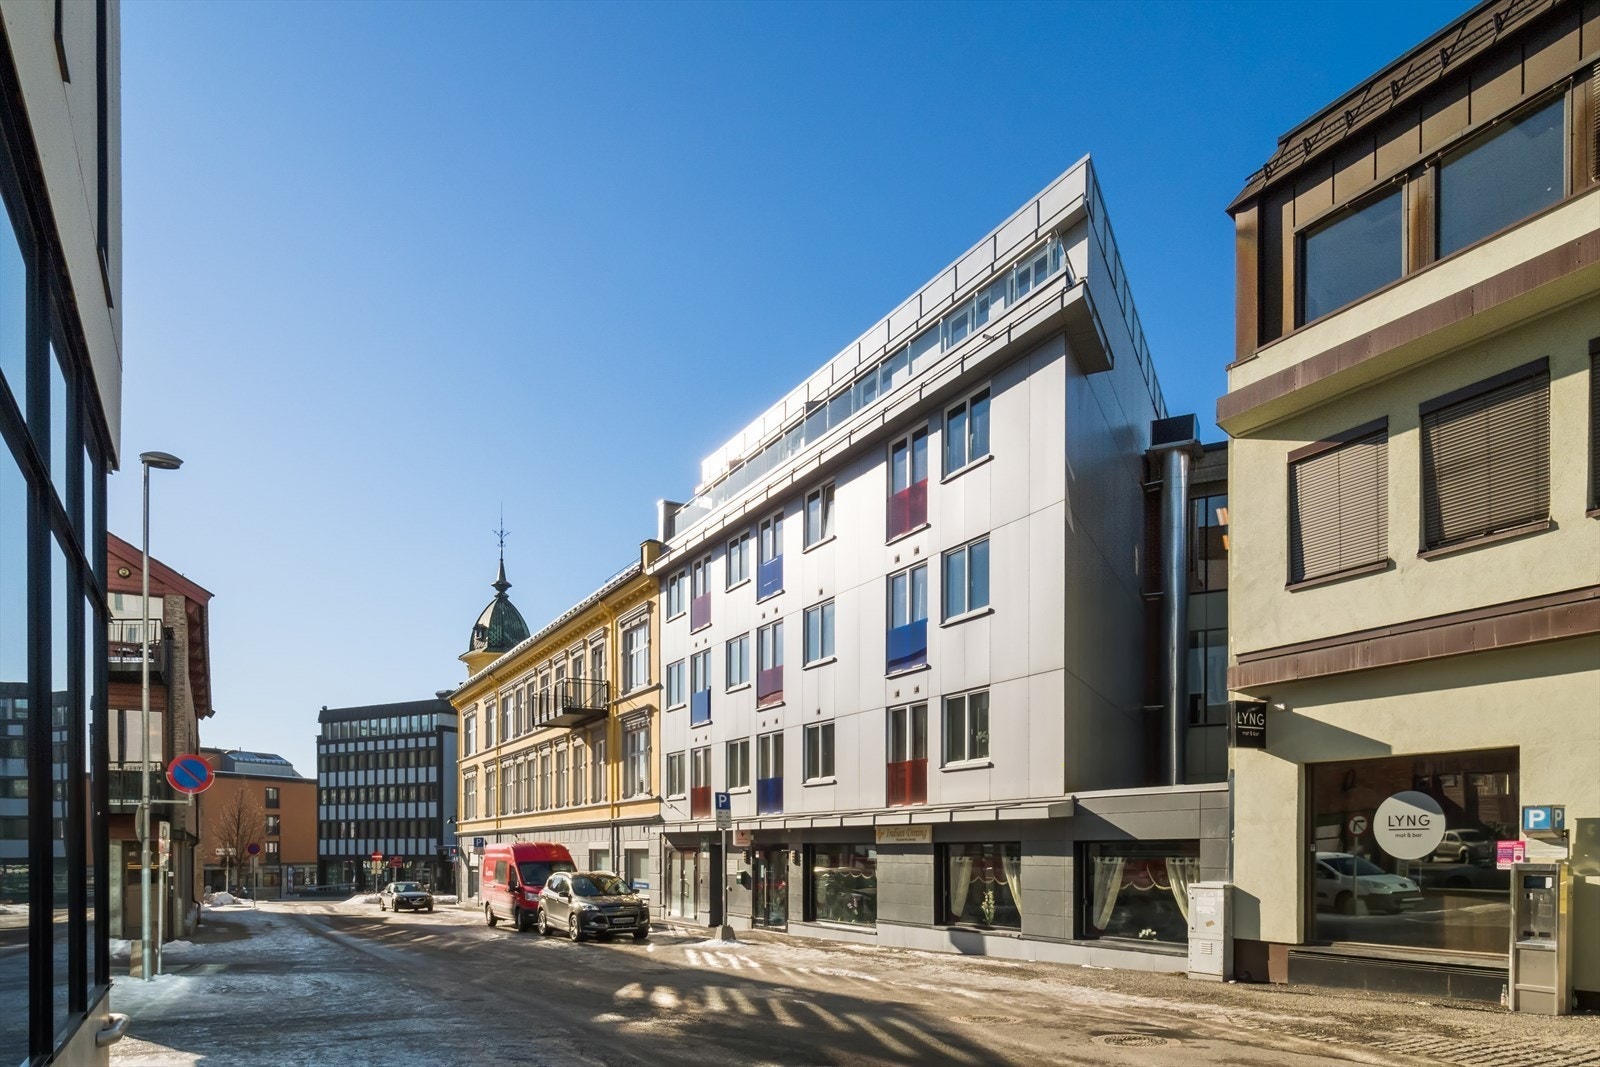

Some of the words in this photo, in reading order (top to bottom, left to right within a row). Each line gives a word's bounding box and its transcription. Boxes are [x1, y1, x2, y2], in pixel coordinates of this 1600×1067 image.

[1237, 711, 1265, 726] LYNG
[718, 794, 727, 808] P
[1388, 814, 1430, 827] LYNG
[1529, 809, 1546, 828] P
[1554, 809, 1563, 828] P
[476, 838, 482, 847] P
